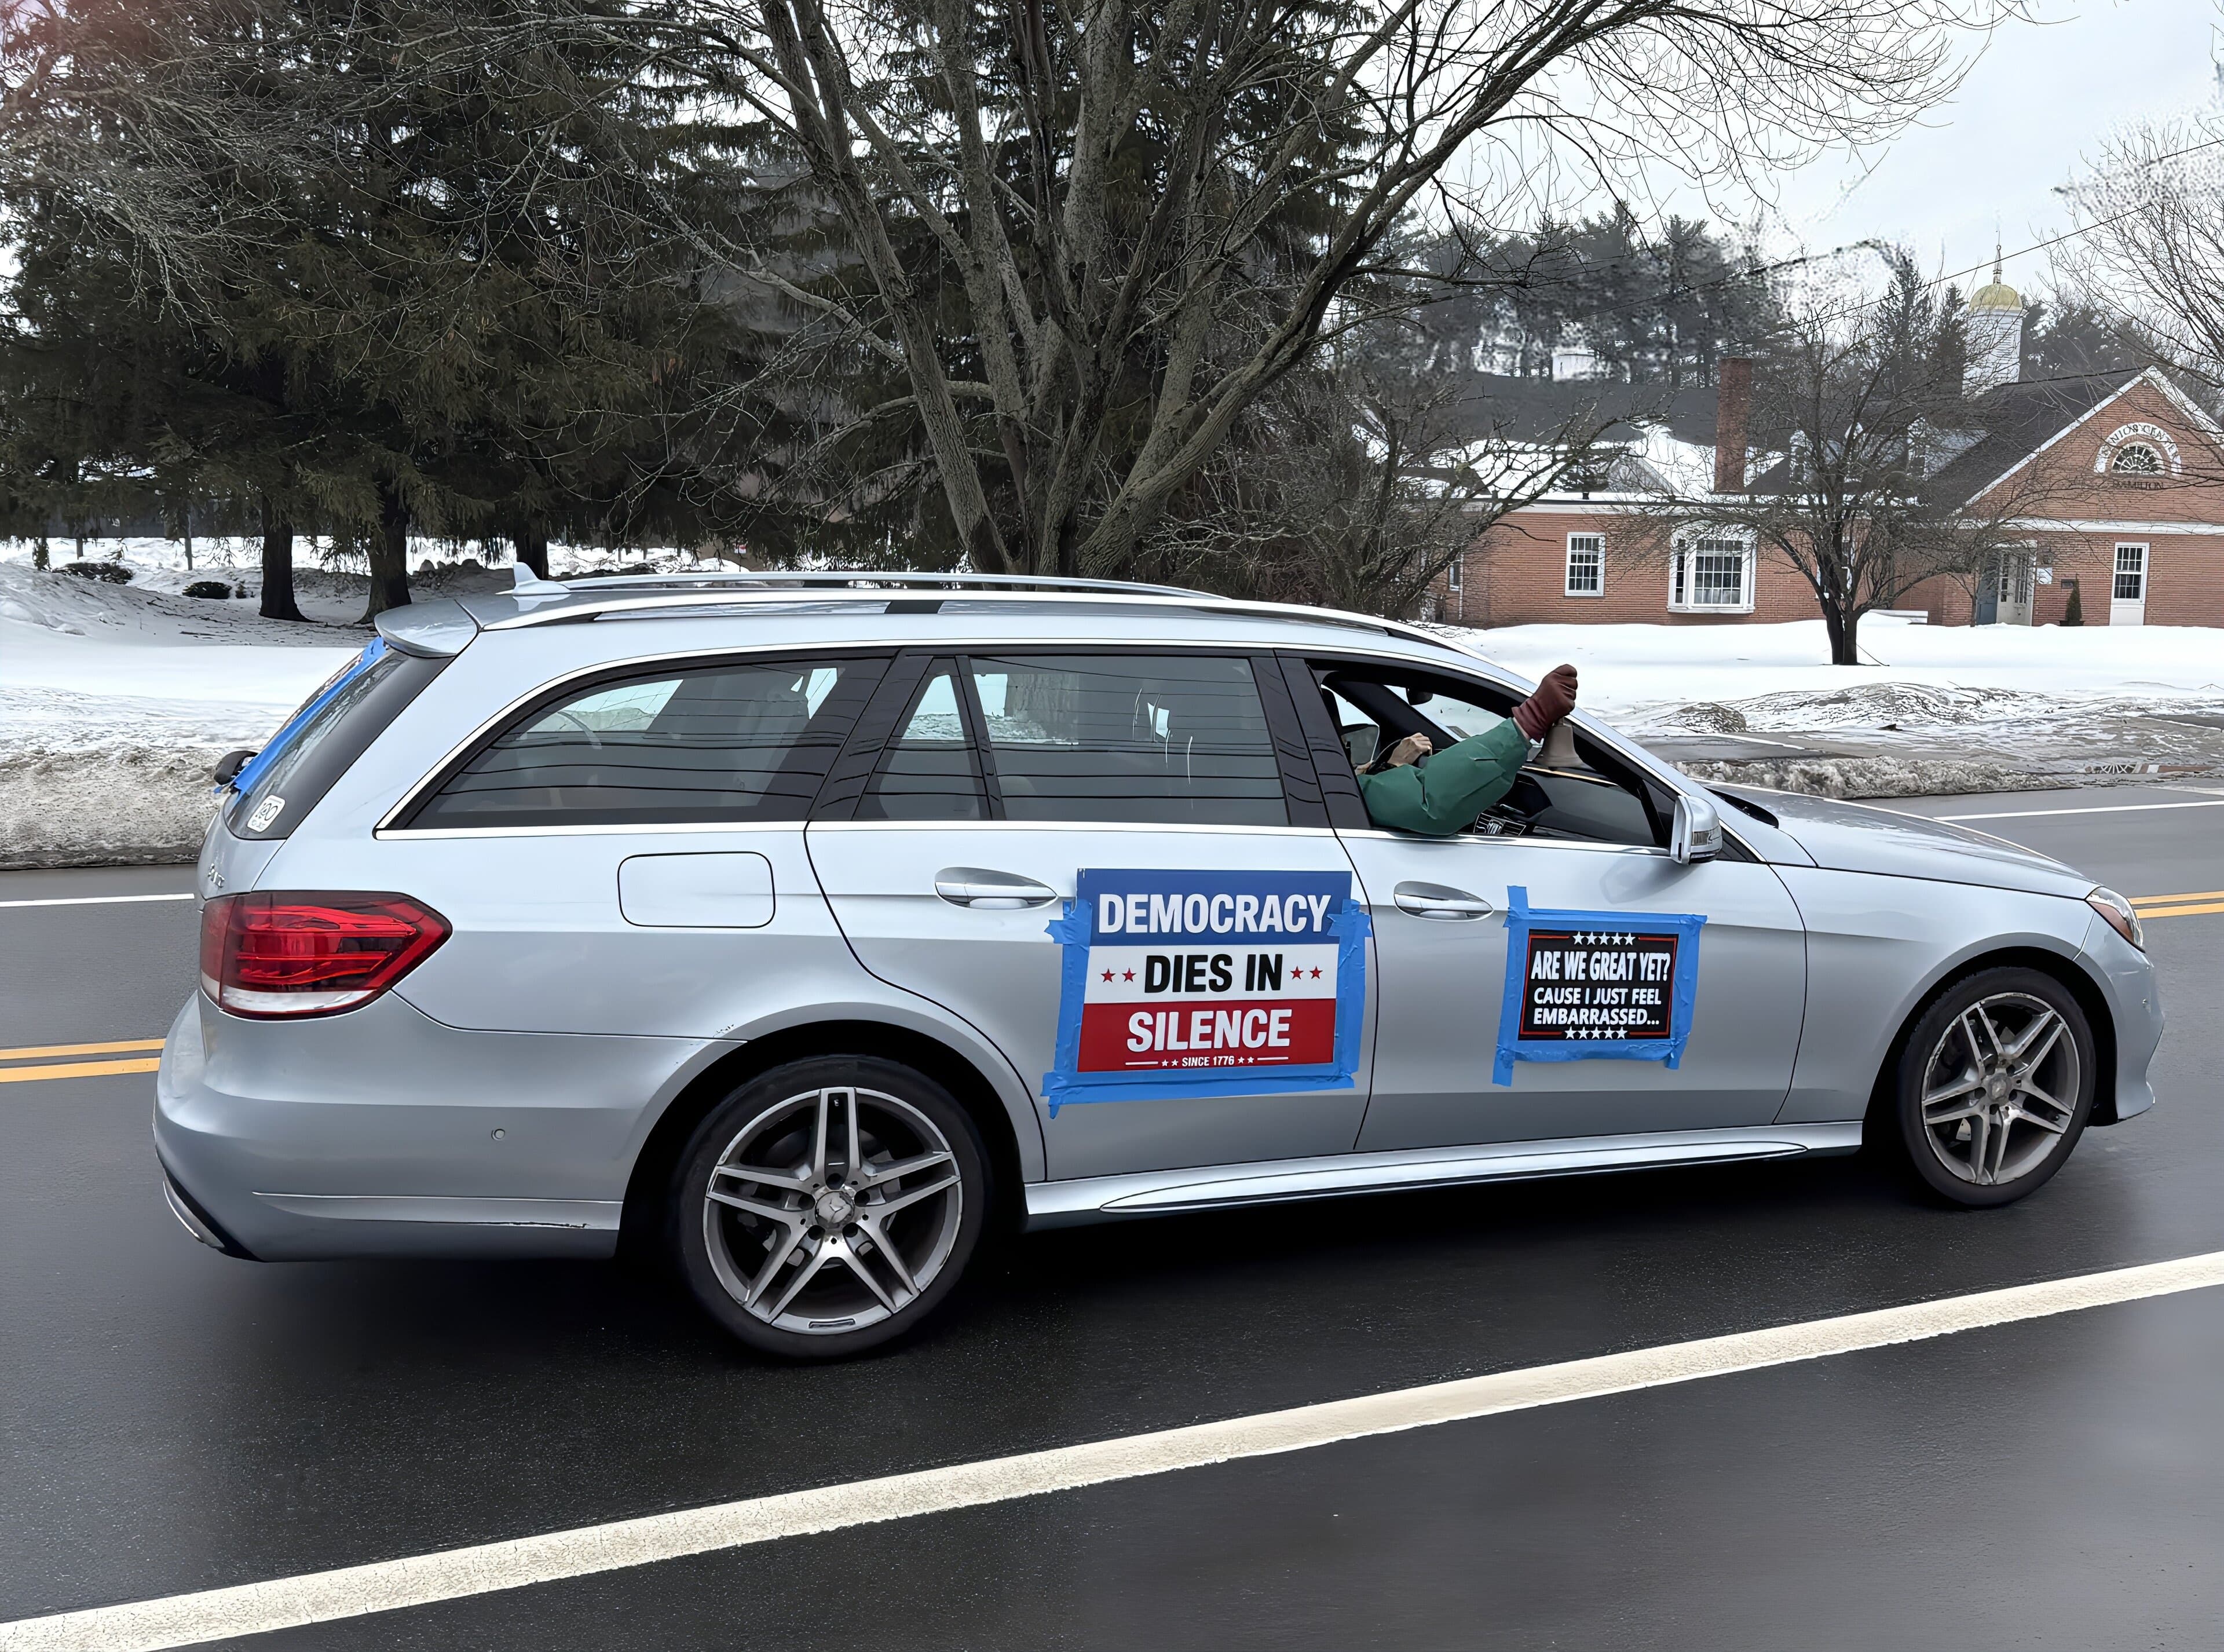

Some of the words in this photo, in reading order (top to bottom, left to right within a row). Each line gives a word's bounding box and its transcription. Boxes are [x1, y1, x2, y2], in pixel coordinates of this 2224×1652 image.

[1099, 894, 1331, 933] DEMOCRACY
[1144, 954, 1232, 993] DIES
[1246, 954, 1282, 991] IN
[1531, 951, 1560, 979] ARE
[1565, 952, 1586, 979] WE
[1590, 952, 1636, 980] GREAT
[1640, 953, 1670, 981] YET?
[1534, 988, 1581, 1004] CAUSE
[1585, 988, 1590, 1004] I
[1593, 988, 1628, 1004] JUST
[1632, 989, 1661, 1004] FEEL
[1128, 1009, 1292, 1051] SILENCE
[1534, 1008, 1659, 1025] EMBARRASSED...
[1182, 1057, 1209, 1066] SINCE
[1213, 1056, 1234, 1065] 1776
